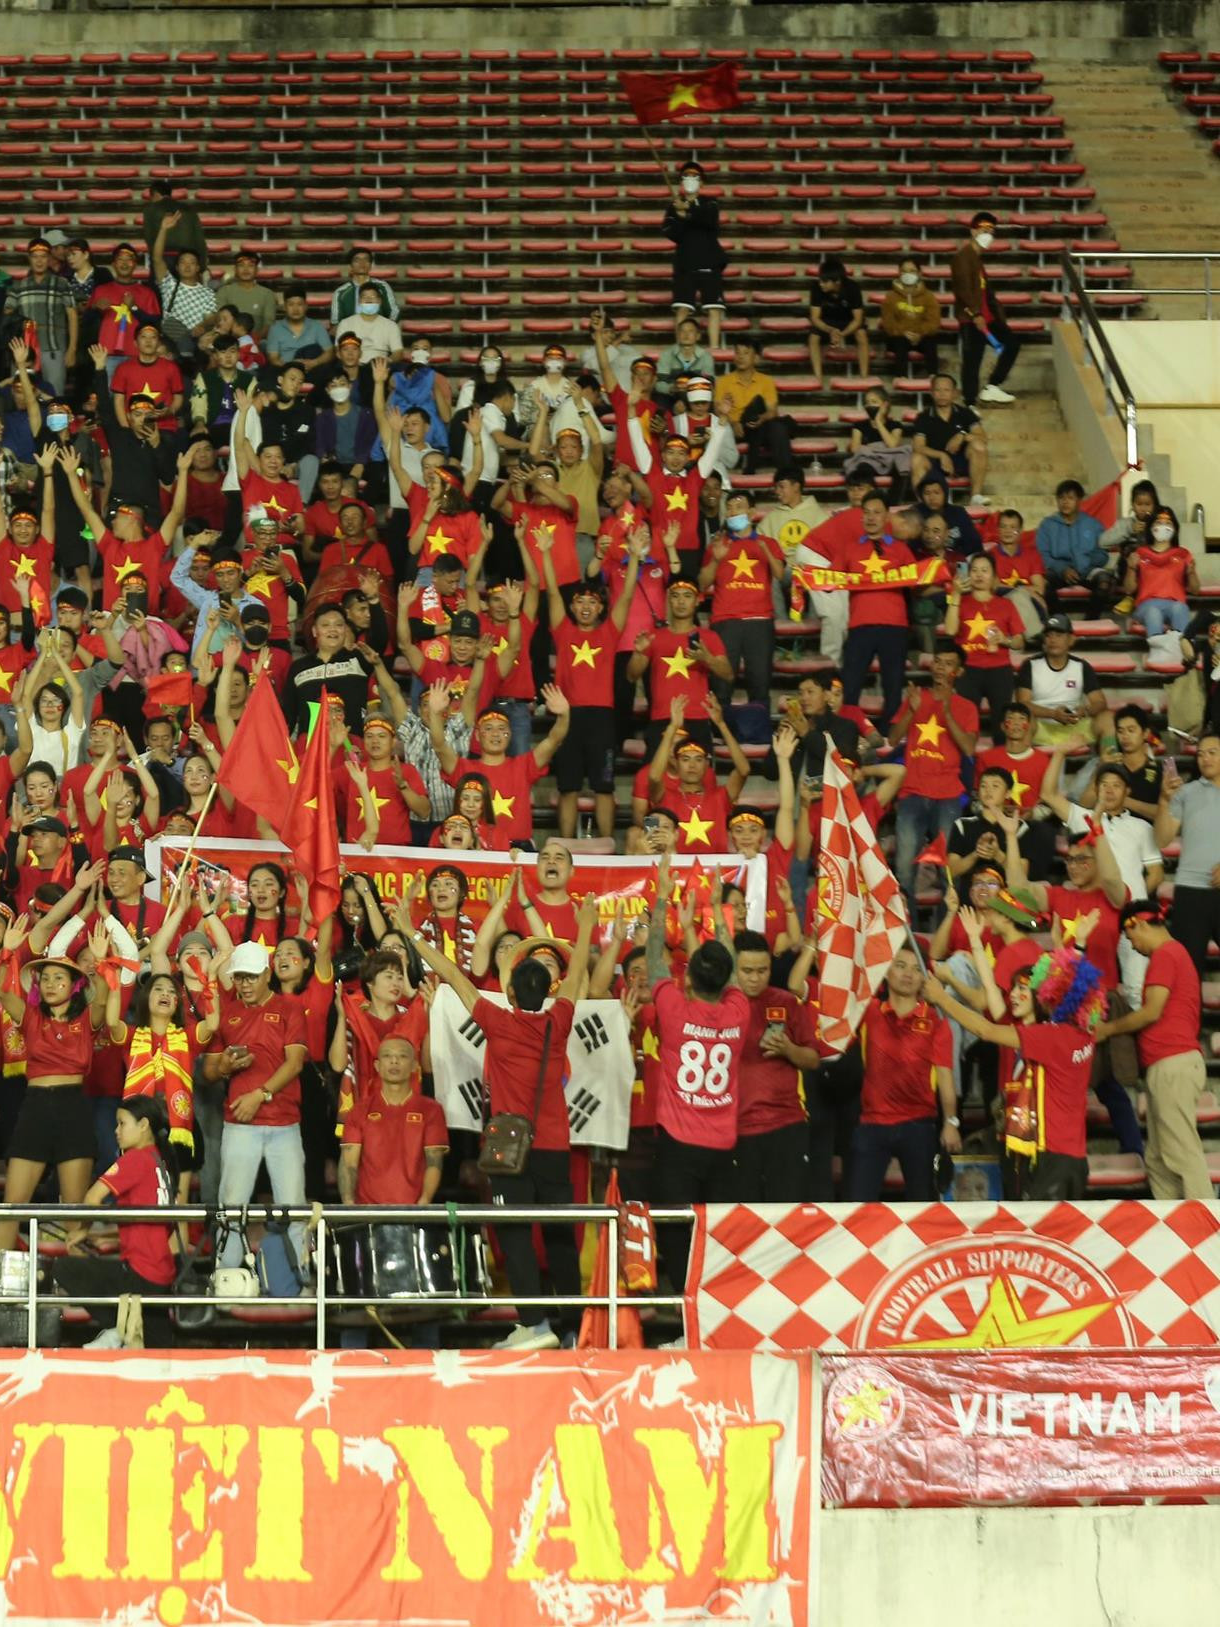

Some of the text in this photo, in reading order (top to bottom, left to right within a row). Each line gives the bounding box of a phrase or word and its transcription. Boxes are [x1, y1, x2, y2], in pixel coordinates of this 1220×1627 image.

[871, 563, 918, 583] NAM
[677, 1040, 732, 1095] 88
[877, 1258, 962, 1338] FOOTBALL
[949, 1391, 1182, 1437] VIETNAM
[381, 1423, 784, 1582] NAM
